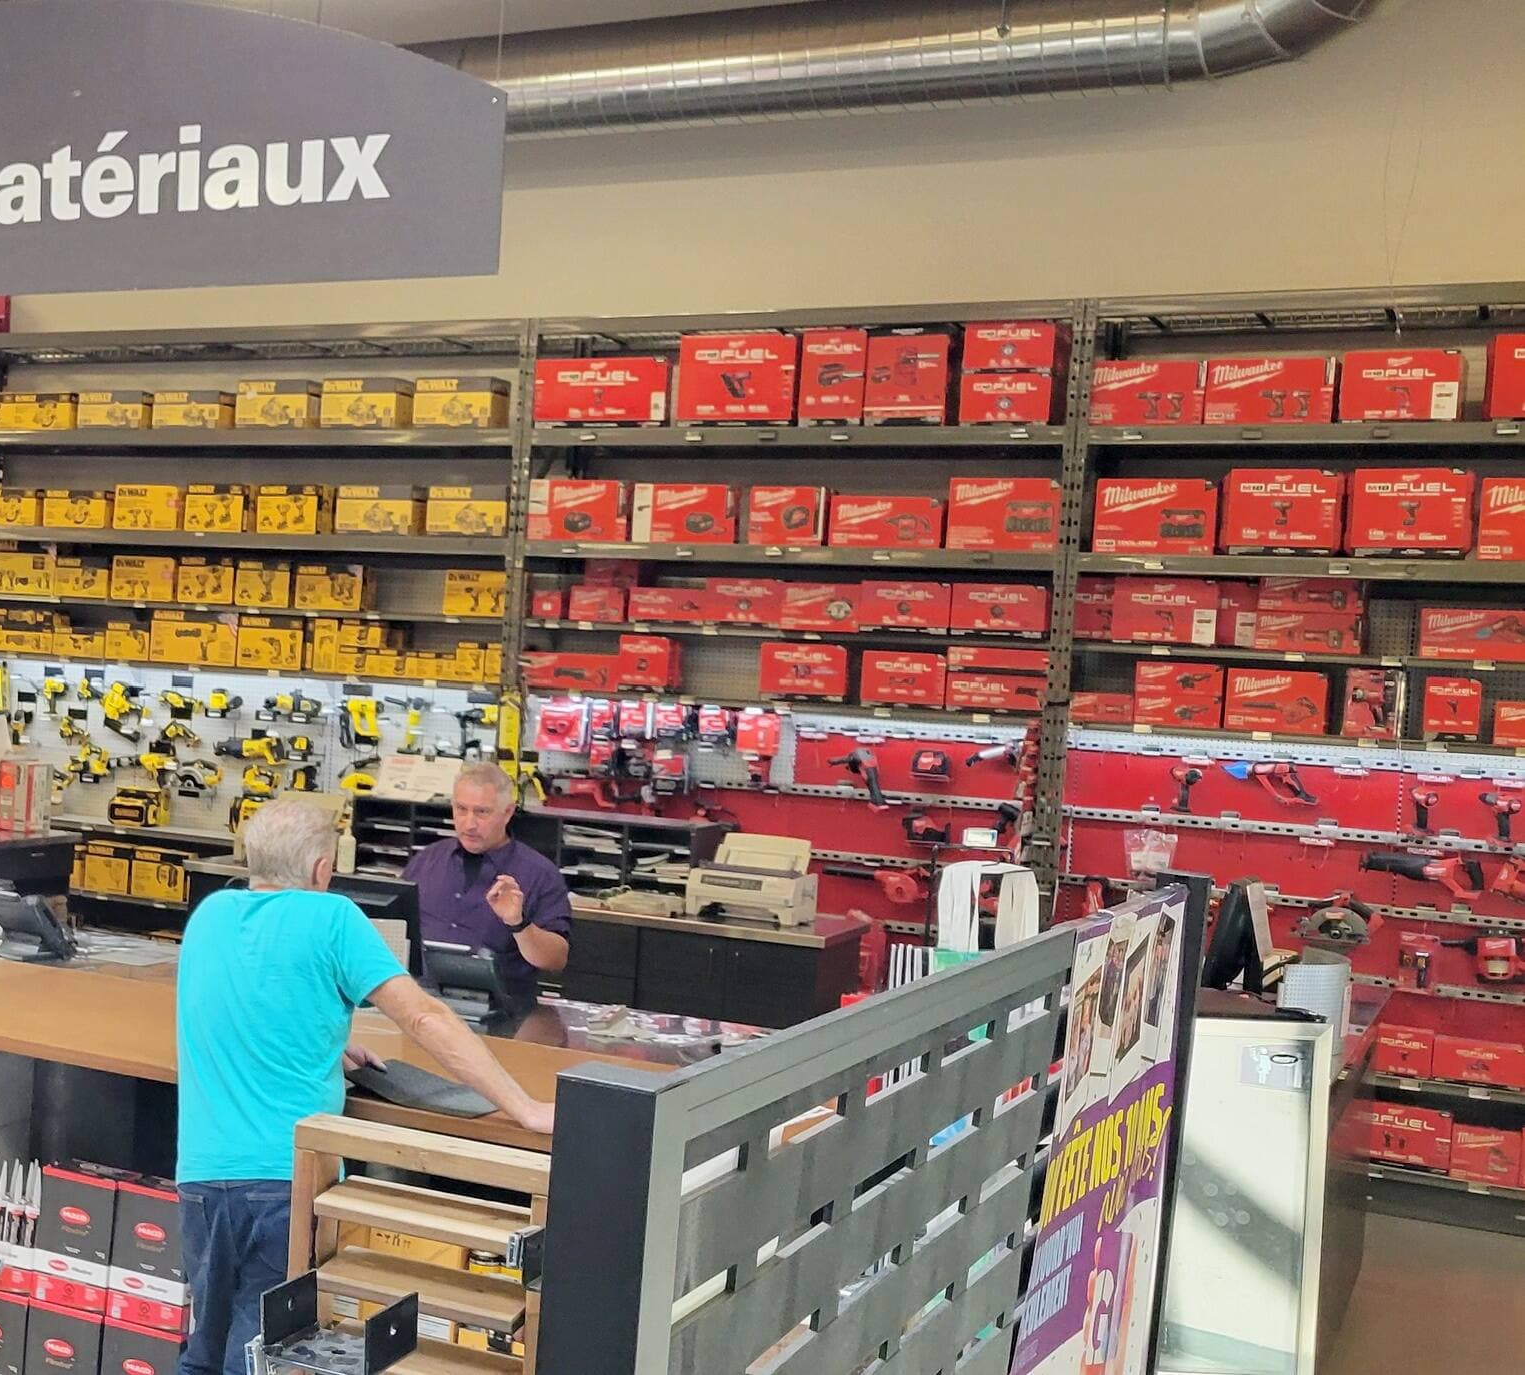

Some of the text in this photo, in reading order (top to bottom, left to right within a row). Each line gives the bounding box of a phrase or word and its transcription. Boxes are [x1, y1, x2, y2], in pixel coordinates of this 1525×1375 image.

[721, 348, 778, 359] FUEL
[582, 370, 639, 382] FUEL
[1093, 363, 1159, 386] Milwaukee
[1213, 360, 1284, 385] Milwaukee
[1385, 368, 1436, 377] FUEL
[955, 480, 1015, 501] Milwaukee
[1104, 481, 1178, 507] Milwaukee
[1266, 483, 1326, 492] FUEL
[1393, 482, 1456, 492] FUEL
[1149, 594, 1197, 604] FUEL
[1427, 612, 1486, 630] Milwaukee
[969, 681, 1010, 691] FUEL
[1235, 675, 1292, 693] Milwaukee
[1380, 1112, 1436, 1131] FUEL
[1088, 1108, 1124, 1192] NOS
